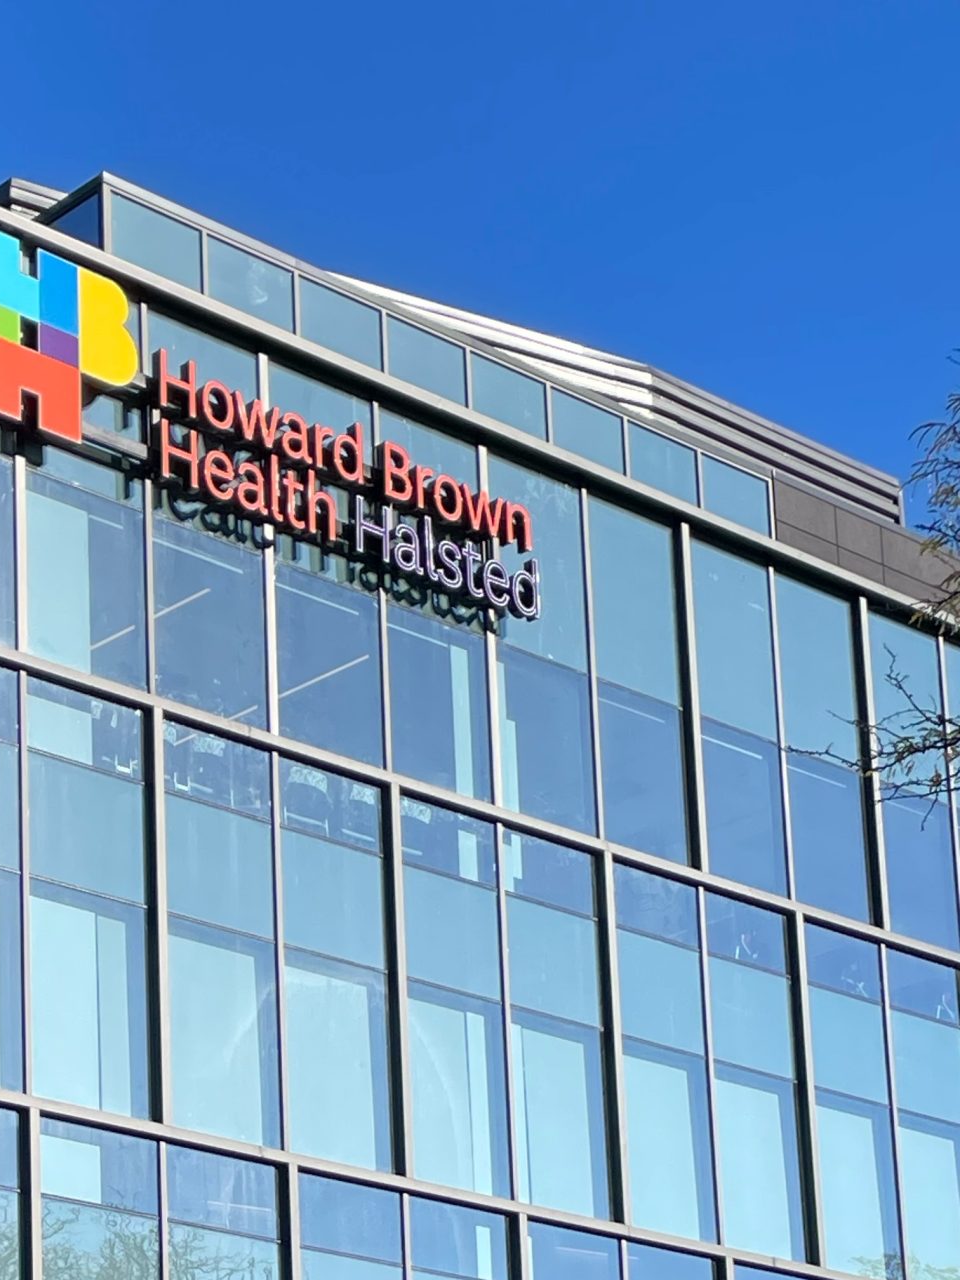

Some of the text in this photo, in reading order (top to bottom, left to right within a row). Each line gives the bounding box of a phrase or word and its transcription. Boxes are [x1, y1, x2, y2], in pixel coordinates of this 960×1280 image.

[155, 348, 533, 552] Howard Brown
[156, 418, 540, 621] Health Halsted
